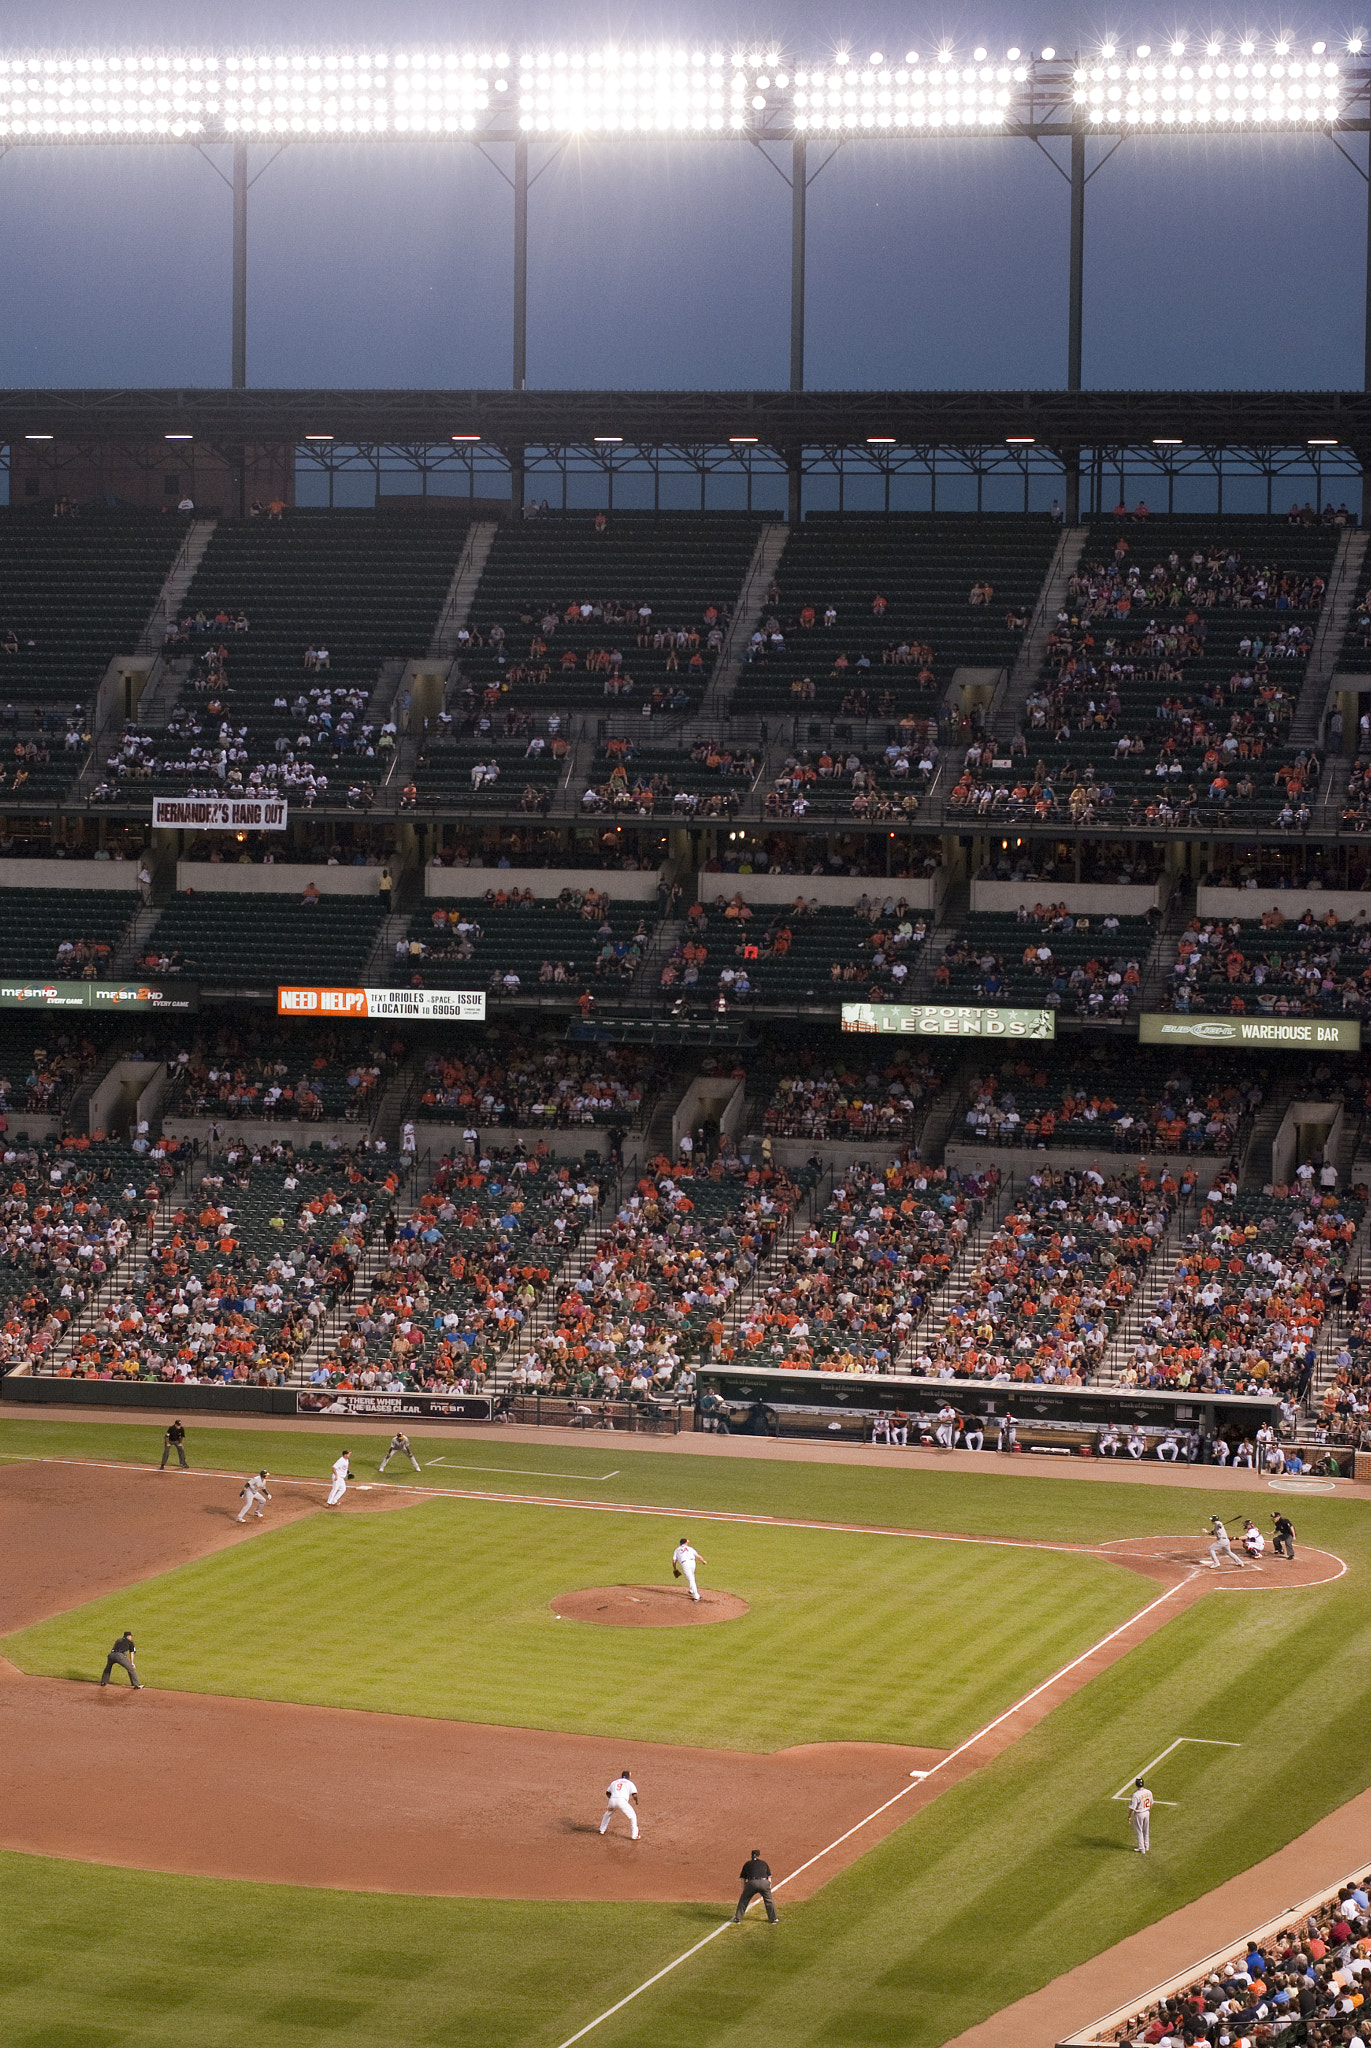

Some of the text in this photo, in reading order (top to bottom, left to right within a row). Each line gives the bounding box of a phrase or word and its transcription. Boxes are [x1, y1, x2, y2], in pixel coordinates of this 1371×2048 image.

[232, 804, 262, 824] HANG
[265, 805, 284, 824] OUT
[281, 991, 364, 1011] NEED HELP?
[371, 994, 387, 1002] TEXT
[389, 992, 424, 1003] ORIOLES
[458, 994, 482, 1005] ISSUE
[377, 1003, 419, 1014] LOCATION
[422, 1006, 430, 1014] TO
[432, 1005, 460, 1015] 69050
[910, 1007, 999, 1019] SPORTS
[882, 1018, 1027, 1035] LEGENDS
[1241, 1024, 1312, 1041] WAREHOUSE
[1317, 1027, 1339, 1042] BAR
[337, 1396, 402, 1406] BE THERE WHEN
[393, 1405, 422, 1413] CLEAR.
[430, 1404, 464, 1412] masn
[616, 1783, 623, 1791] 9
[1143, 1798, 1150, 1808] 12
